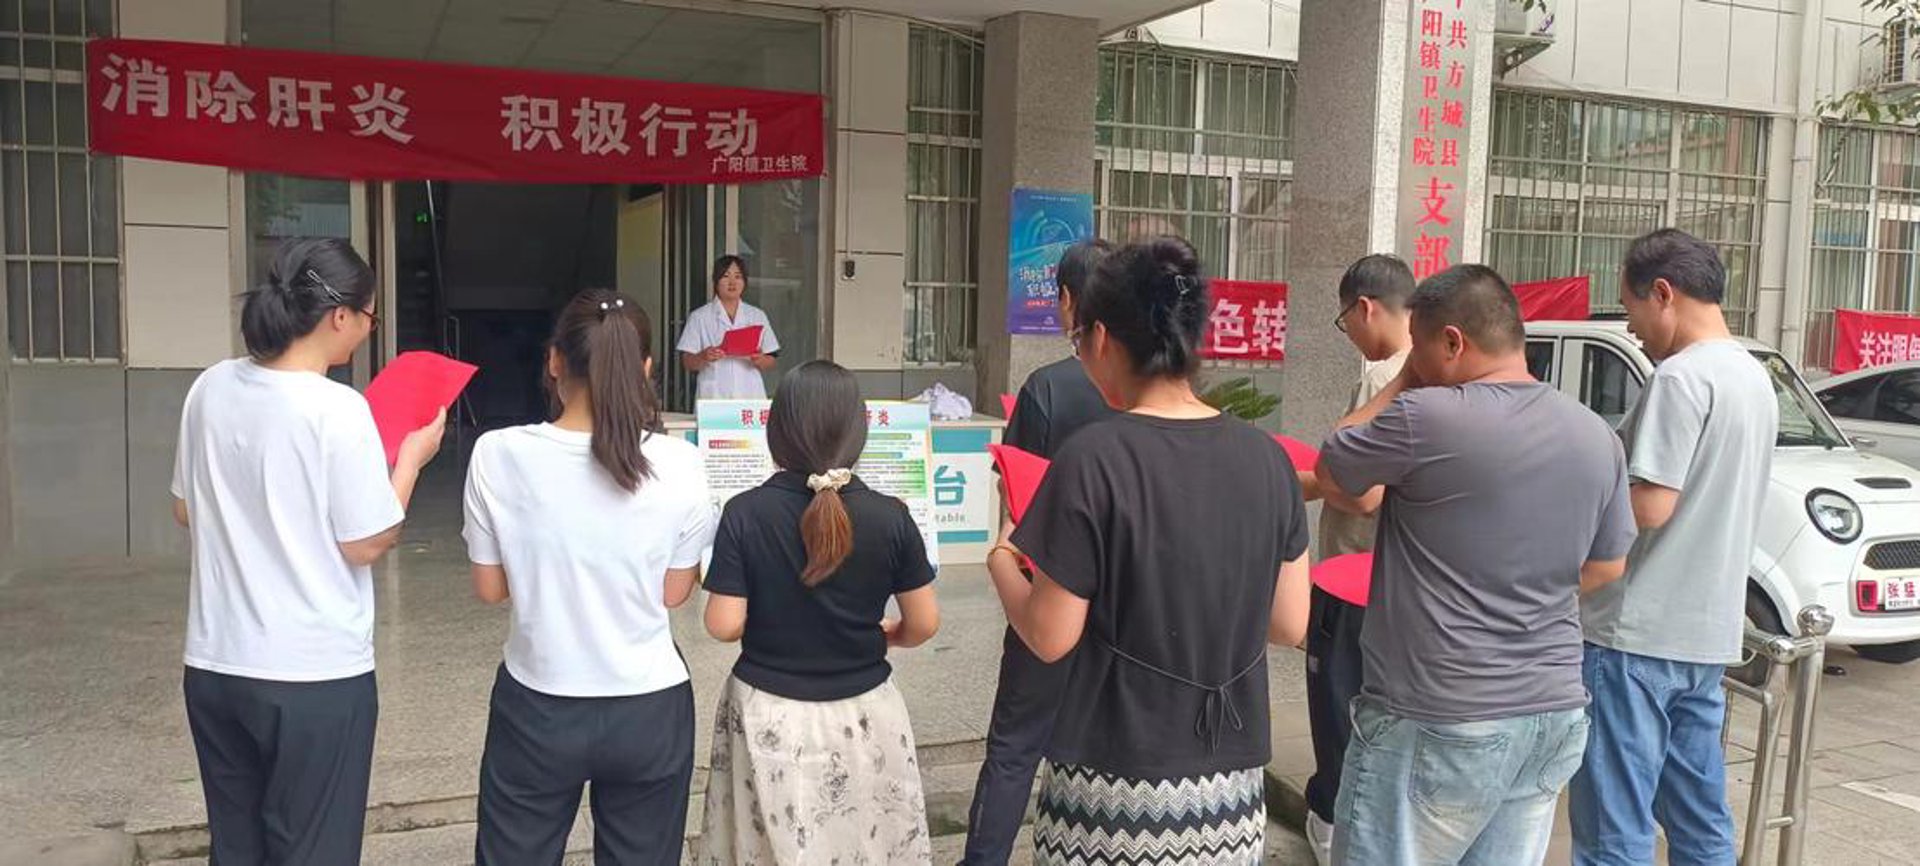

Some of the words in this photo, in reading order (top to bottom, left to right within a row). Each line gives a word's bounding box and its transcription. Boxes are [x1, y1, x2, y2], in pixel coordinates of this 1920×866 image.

[101, 53, 415, 144] 消除肝炎
[501, 95, 759, 157] 积极行动
[1412, 0, 1443, 167] 阳镇卫生院
[711, 154, 808, 174] 广阳镇卫生院
[1413, 177, 1455, 279] 支部
[1209, 298, 1286, 357] 色转
[935, 464, 966, 506] 台
